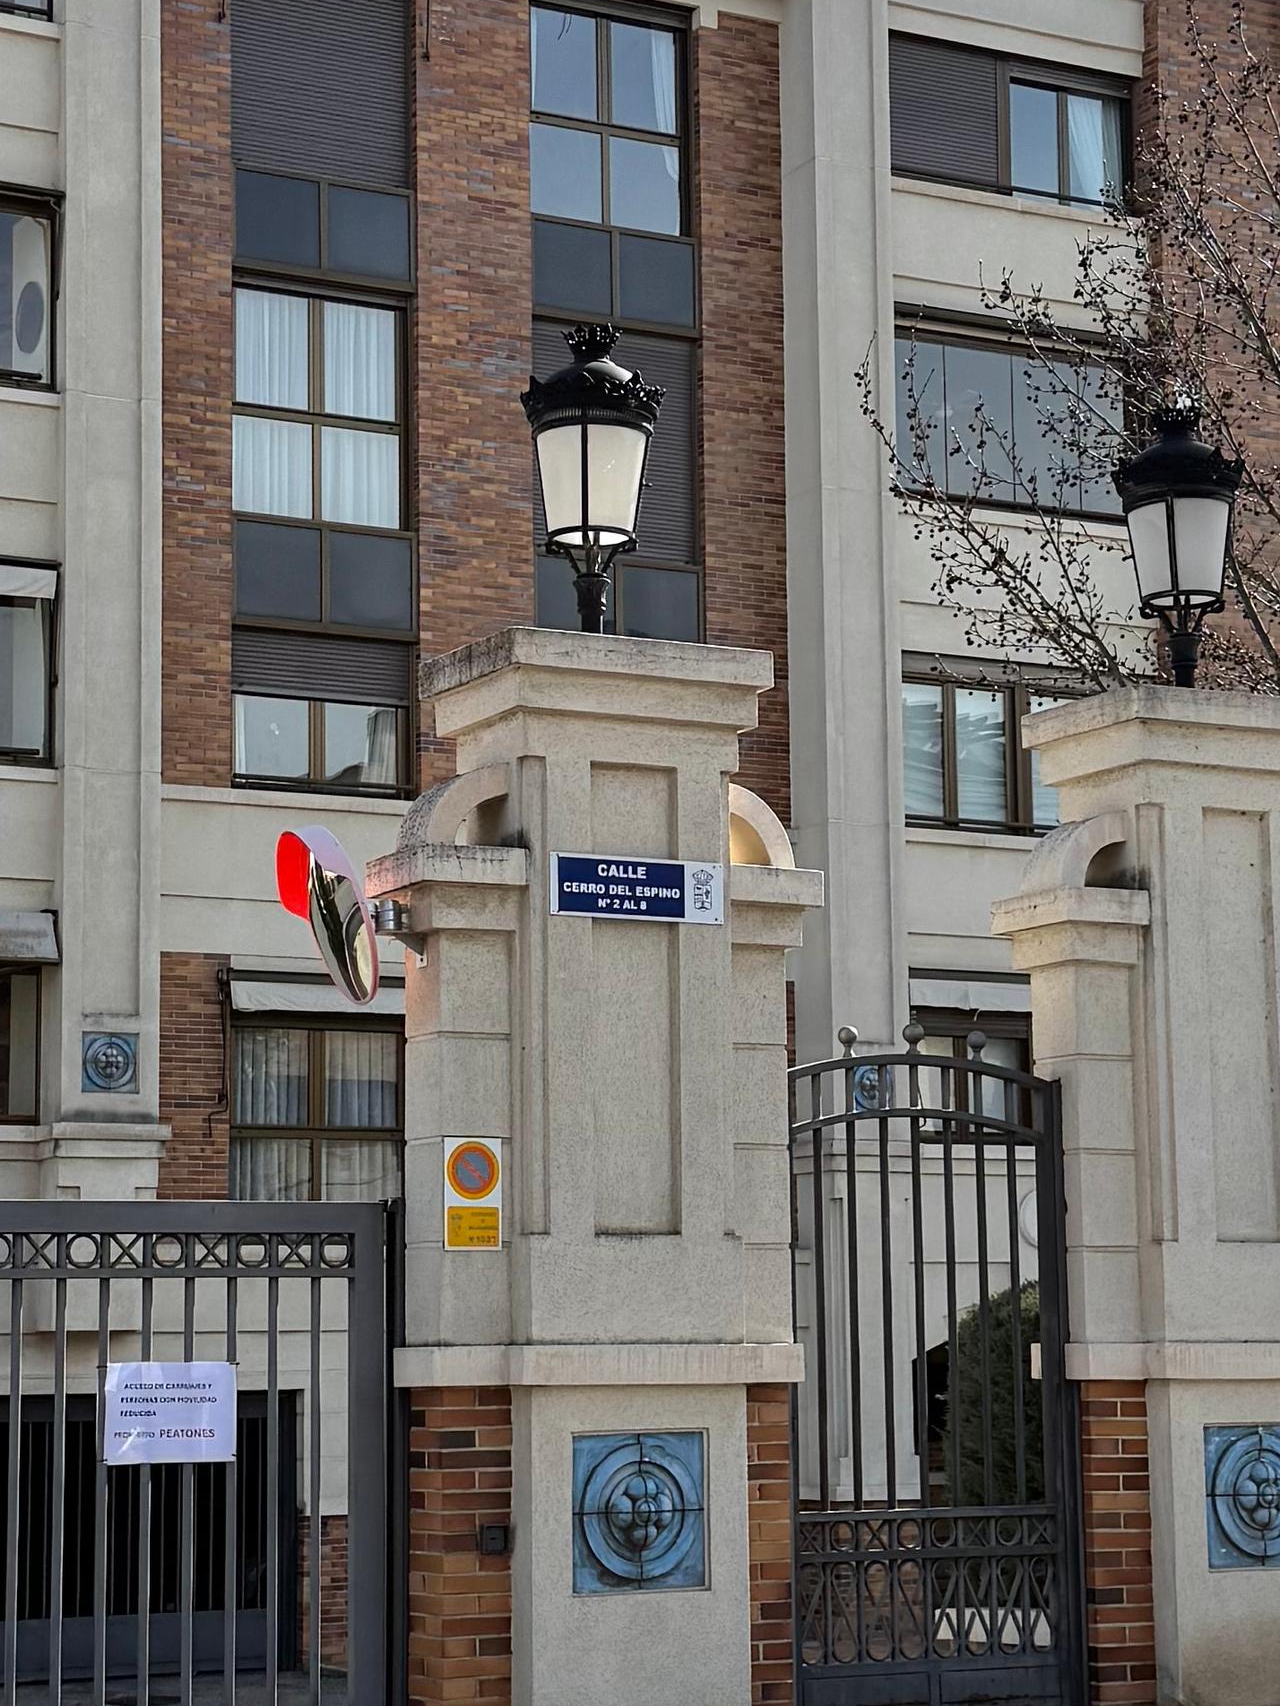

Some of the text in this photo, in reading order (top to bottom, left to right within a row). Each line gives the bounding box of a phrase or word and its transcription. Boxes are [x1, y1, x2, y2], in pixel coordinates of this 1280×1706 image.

[598, 864, 647, 879] CALLE
[563, 881, 680, 899] CERRO DEL ESPINO
[613, 900, 620, 909] 2
[623, 901, 637, 910] AL
[640, 901, 647, 910] 8
[159, 1428, 215, 1438] PEATONES
